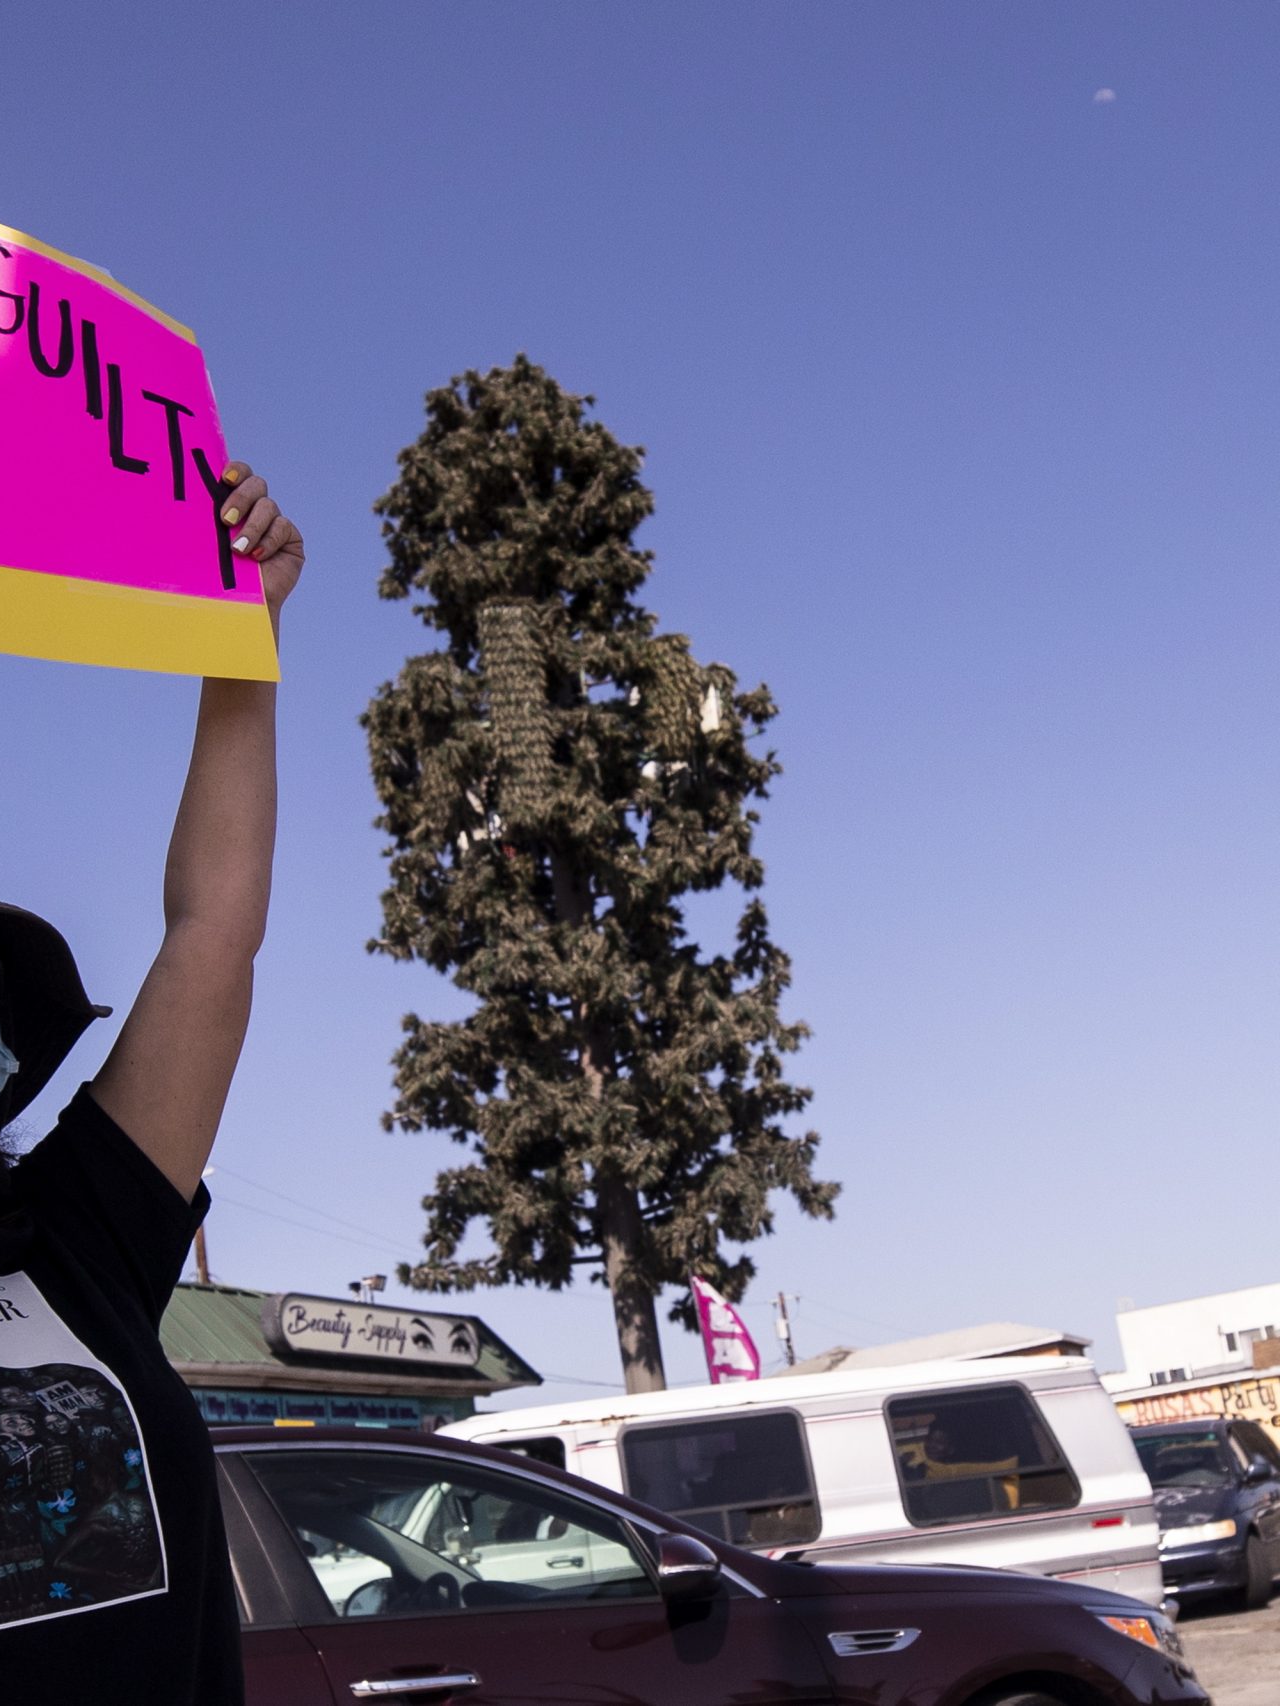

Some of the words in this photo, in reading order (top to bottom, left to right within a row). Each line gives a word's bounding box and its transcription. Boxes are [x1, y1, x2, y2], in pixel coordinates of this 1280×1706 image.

[288, 1305, 352, 1349] Beauty
[357, 1314, 407, 1354] Supply
[1220, 1381, 1278, 1414] Party
